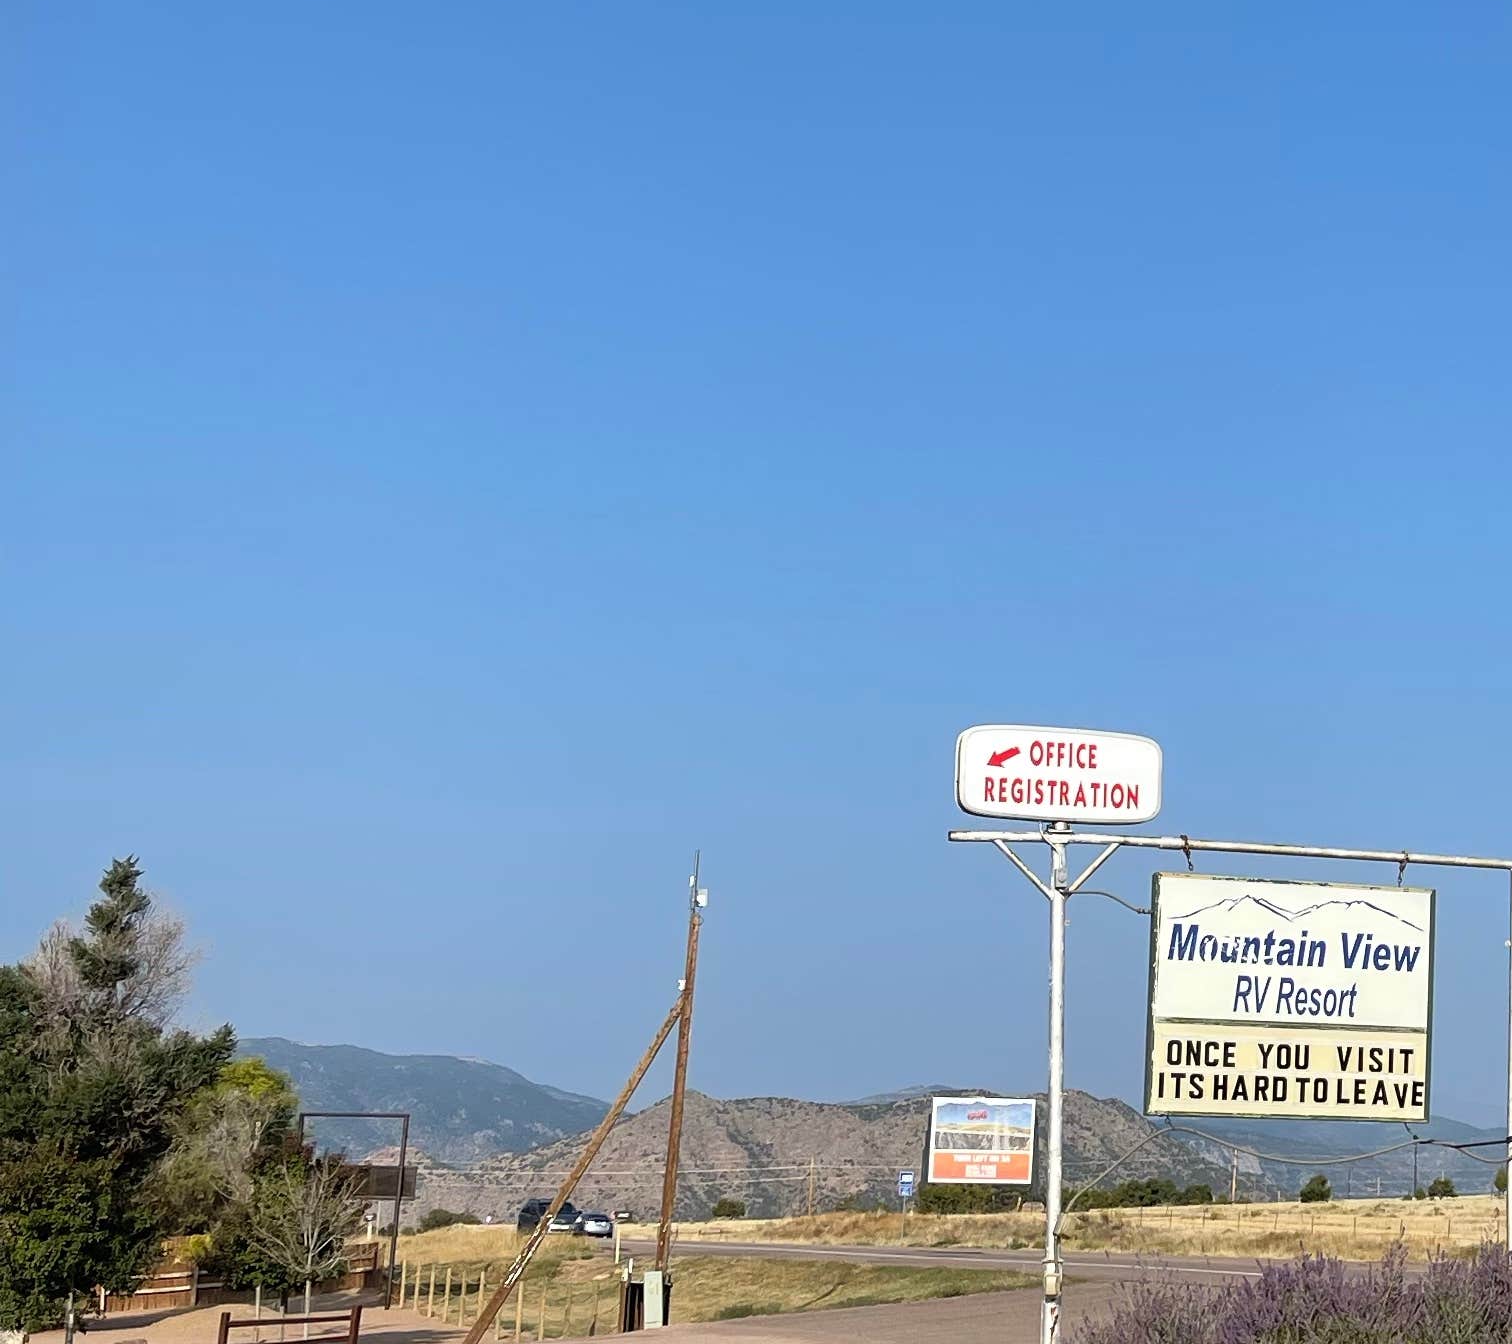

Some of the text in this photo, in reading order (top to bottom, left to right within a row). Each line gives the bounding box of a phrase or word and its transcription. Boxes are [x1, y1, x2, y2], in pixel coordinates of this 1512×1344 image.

[1030, 740, 1097, 769] OFFICE
[985, 776, 1139, 809] REGISTRATION
[1168, 923, 1420, 972] Mountain View
[1233, 975, 1357, 1017] RV Resort
[1167, 1040, 1414, 1074] ONCE YOU VISIT
[1158, 1072, 1424, 1108] ITS HARD TO LEAVE
